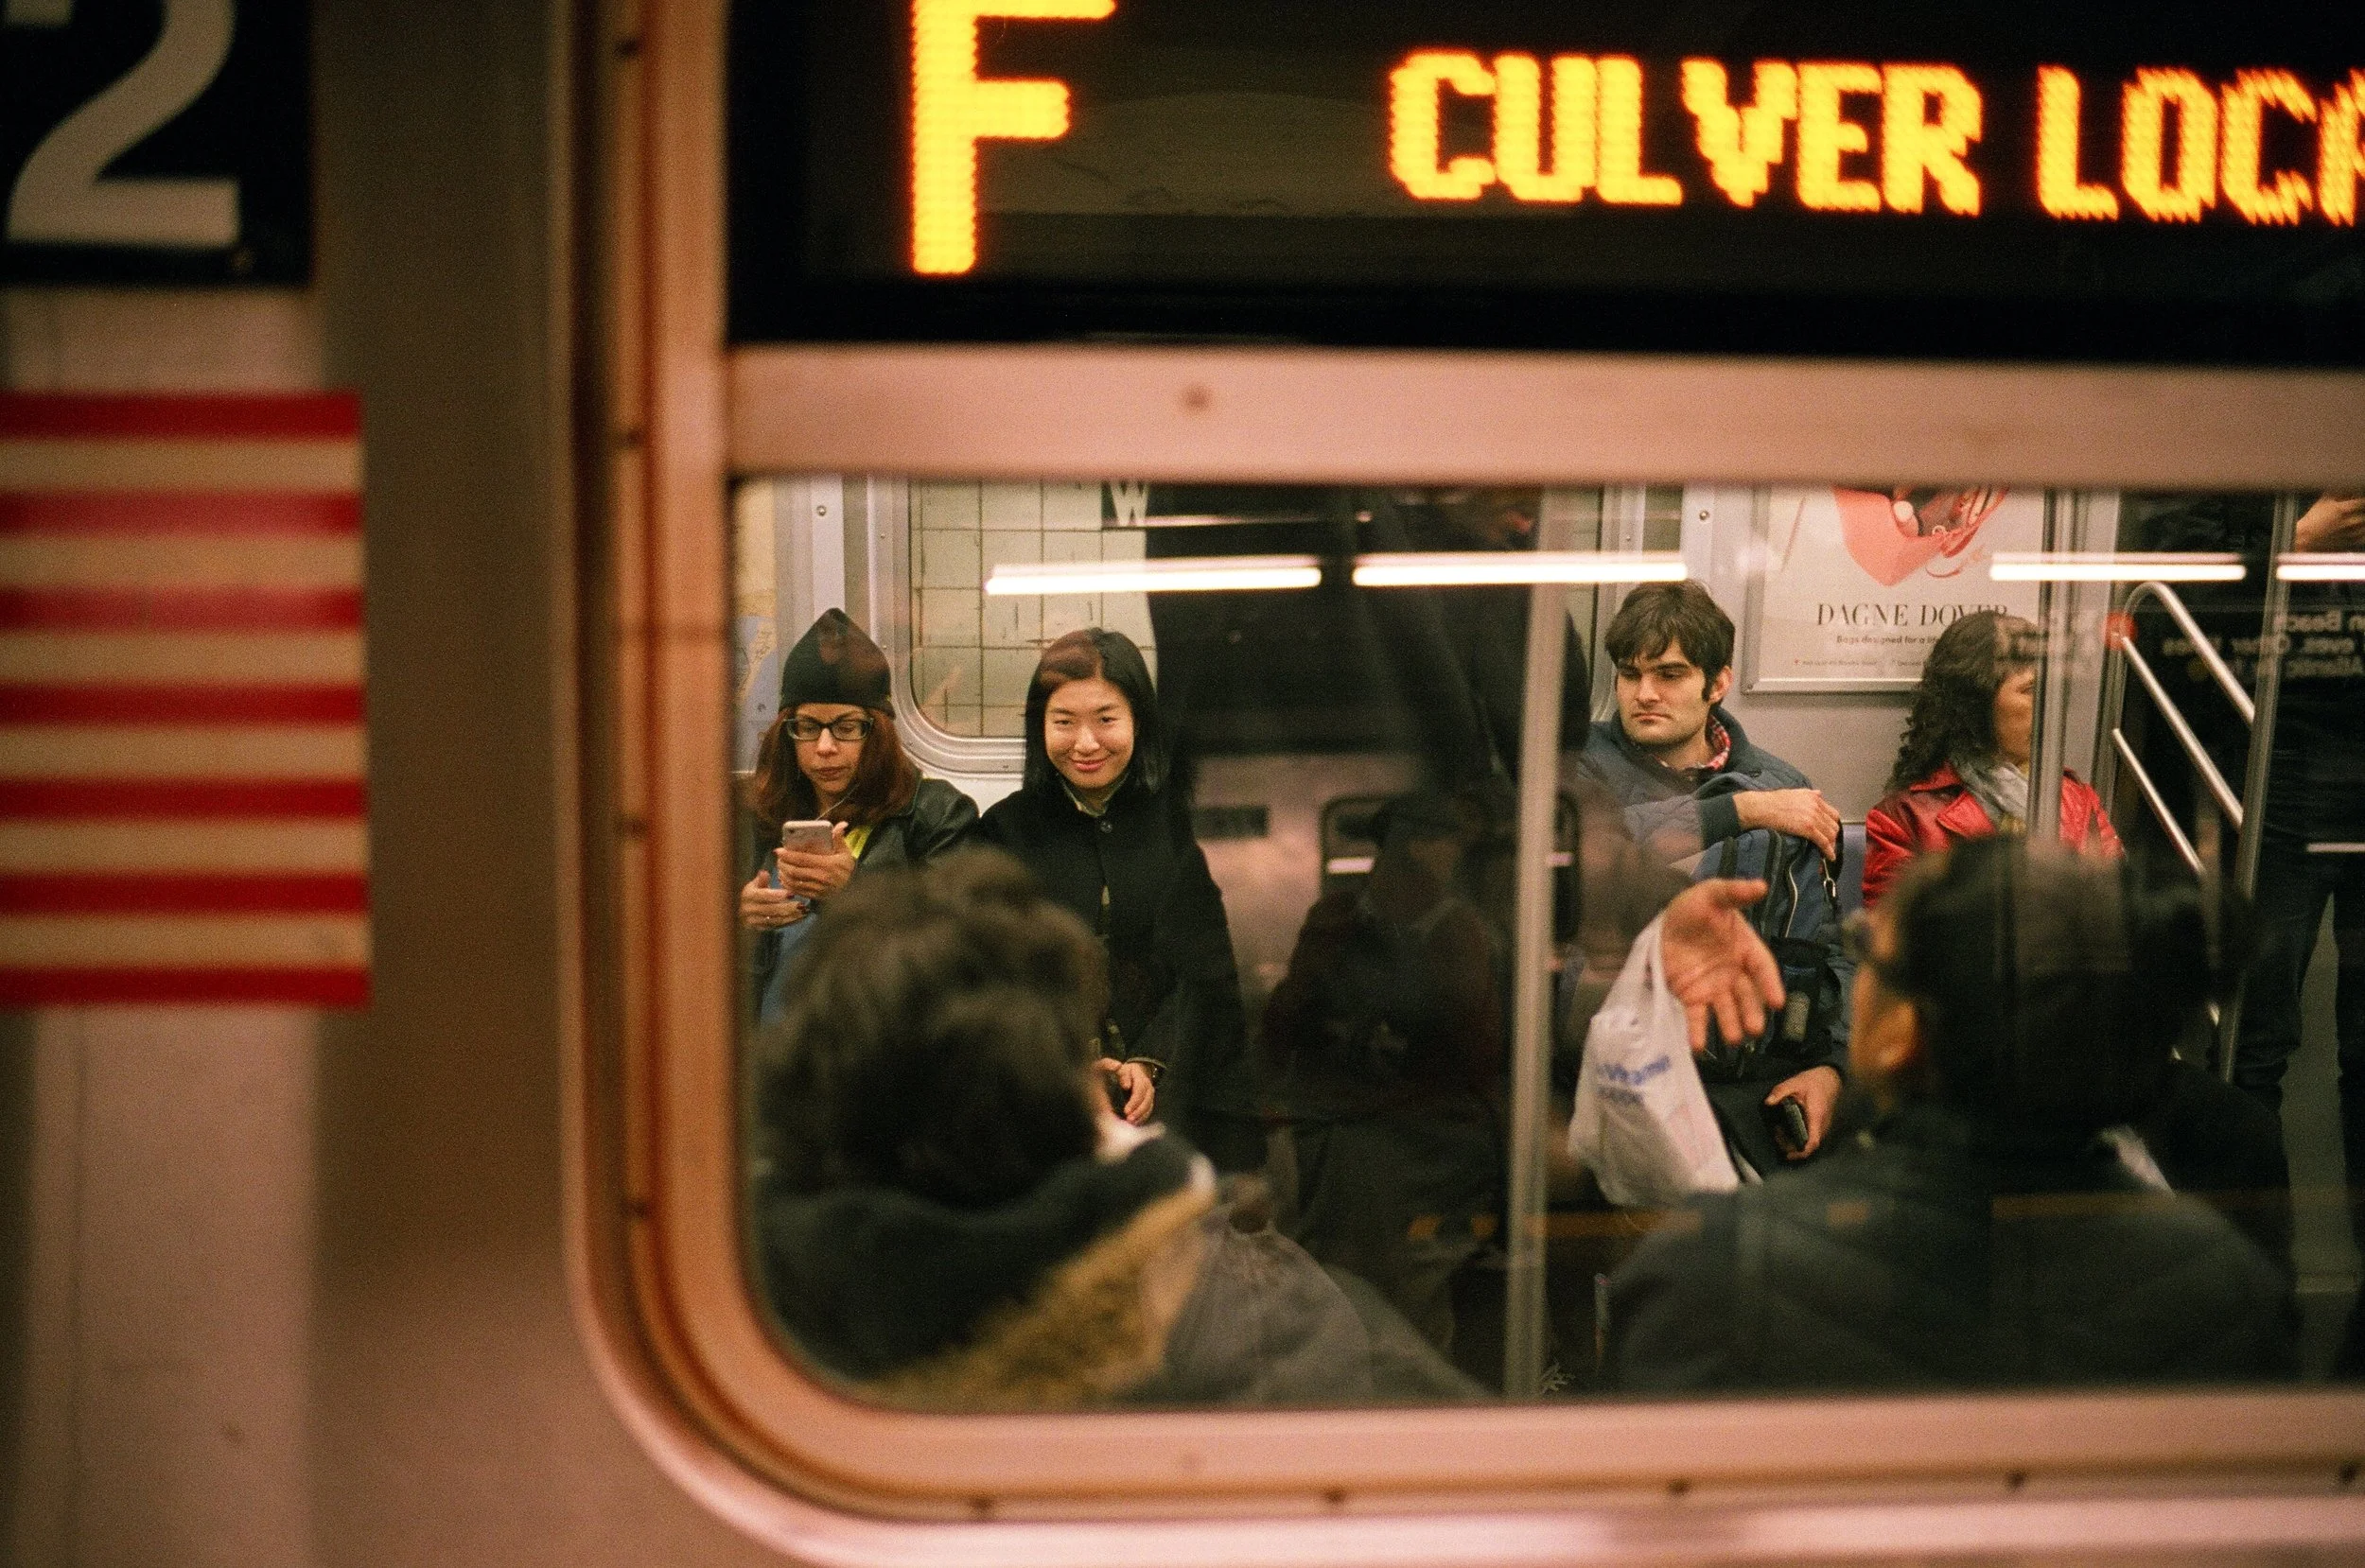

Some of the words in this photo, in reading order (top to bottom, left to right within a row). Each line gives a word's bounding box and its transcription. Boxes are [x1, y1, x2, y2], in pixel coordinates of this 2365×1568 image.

[6, 0, 240, 250] 2
[911, 0, 1116, 275] F
[1390, 49, 1982, 218] CULVER
[1108, 480, 1149, 527] W
[1817, 602, 1909, 627] DAGNE
